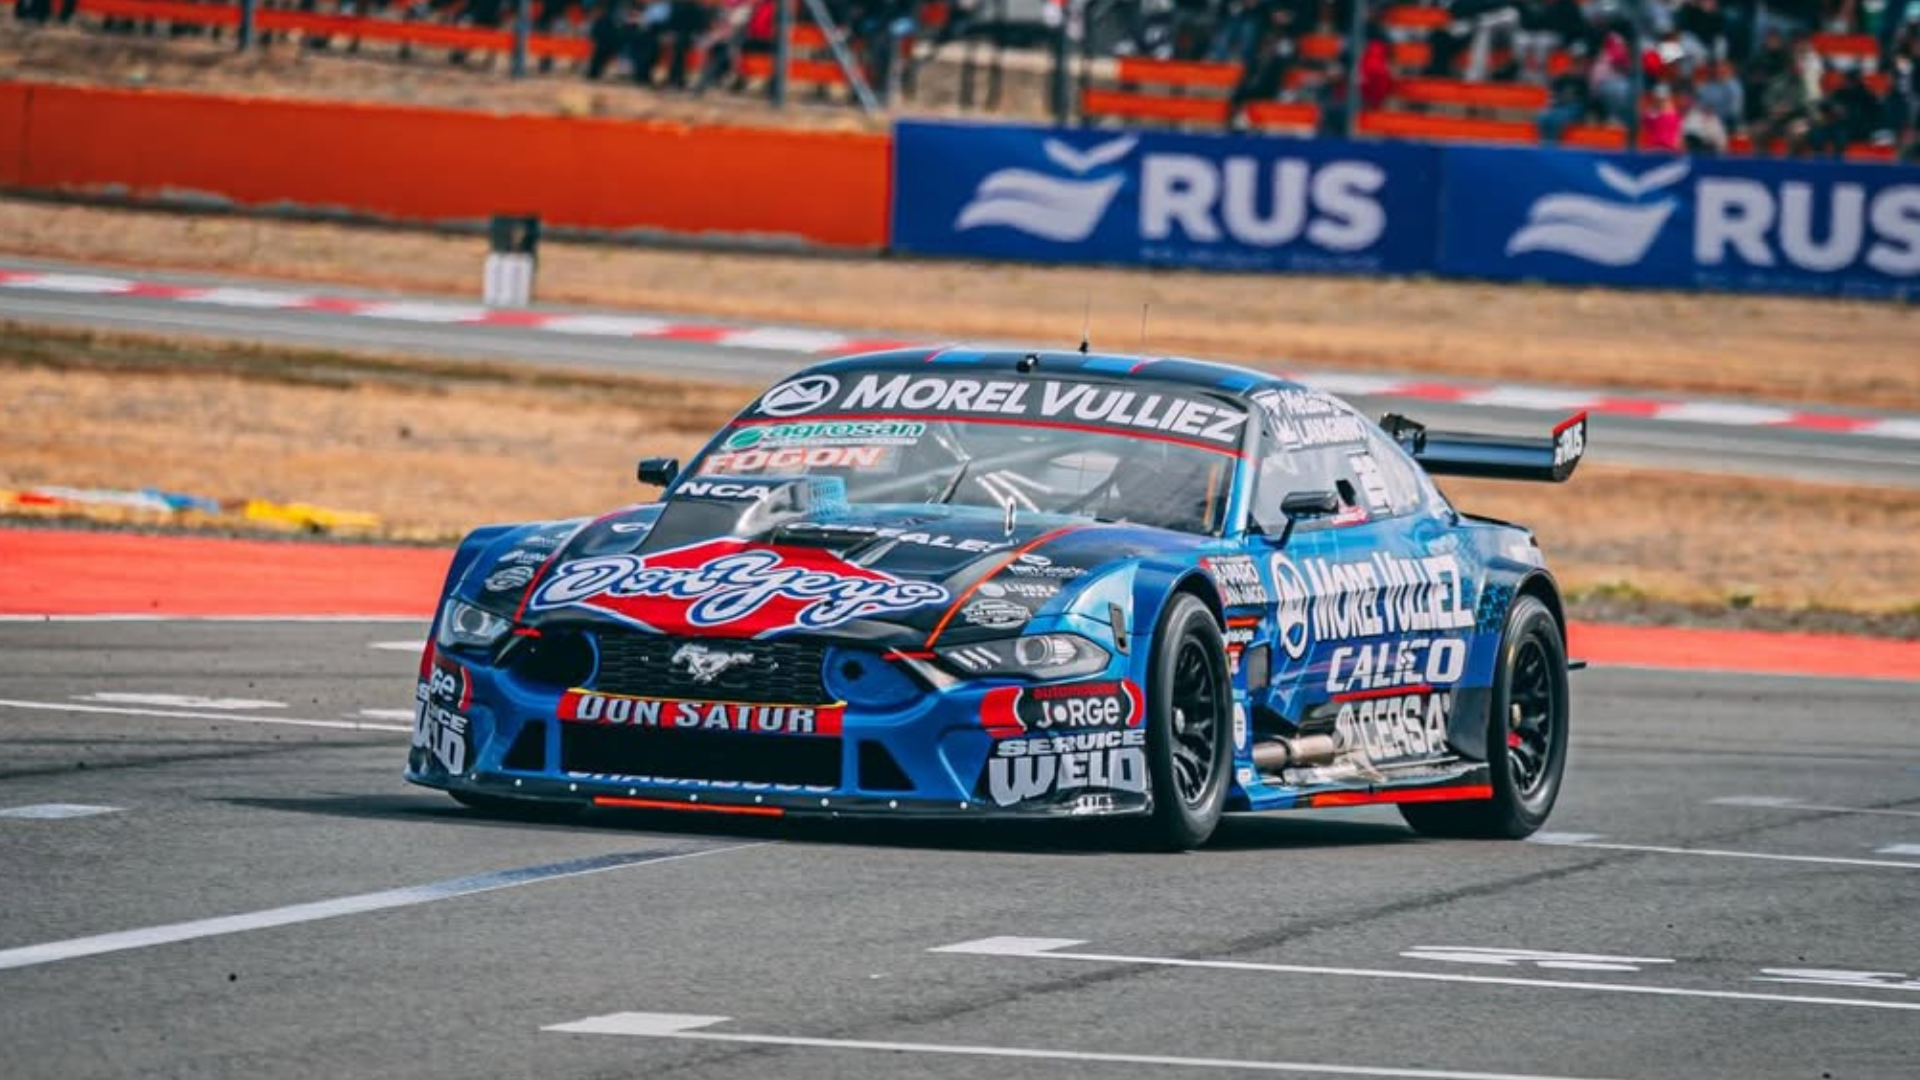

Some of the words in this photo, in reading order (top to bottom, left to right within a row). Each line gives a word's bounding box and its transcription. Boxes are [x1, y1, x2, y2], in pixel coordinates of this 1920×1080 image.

[1139, 153, 1388, 252] RUS
[1694, 176, 1920, 276] RUS
[768, 422, 925, 440] agrosan
[841, 375, 1026, 414] MOREL
[1039, 381, 1249, 442] VULLIEZ
[1304, 558, 1384, 640] MOREL
[1327, 638, 1465, 692] CALICO
[576, 695, 660, 726] DON
[674, 702, 816, 732] SATUR
[997, 729, 1146, 757] SERVICE
[989, 747, 1147, 806] WELD
